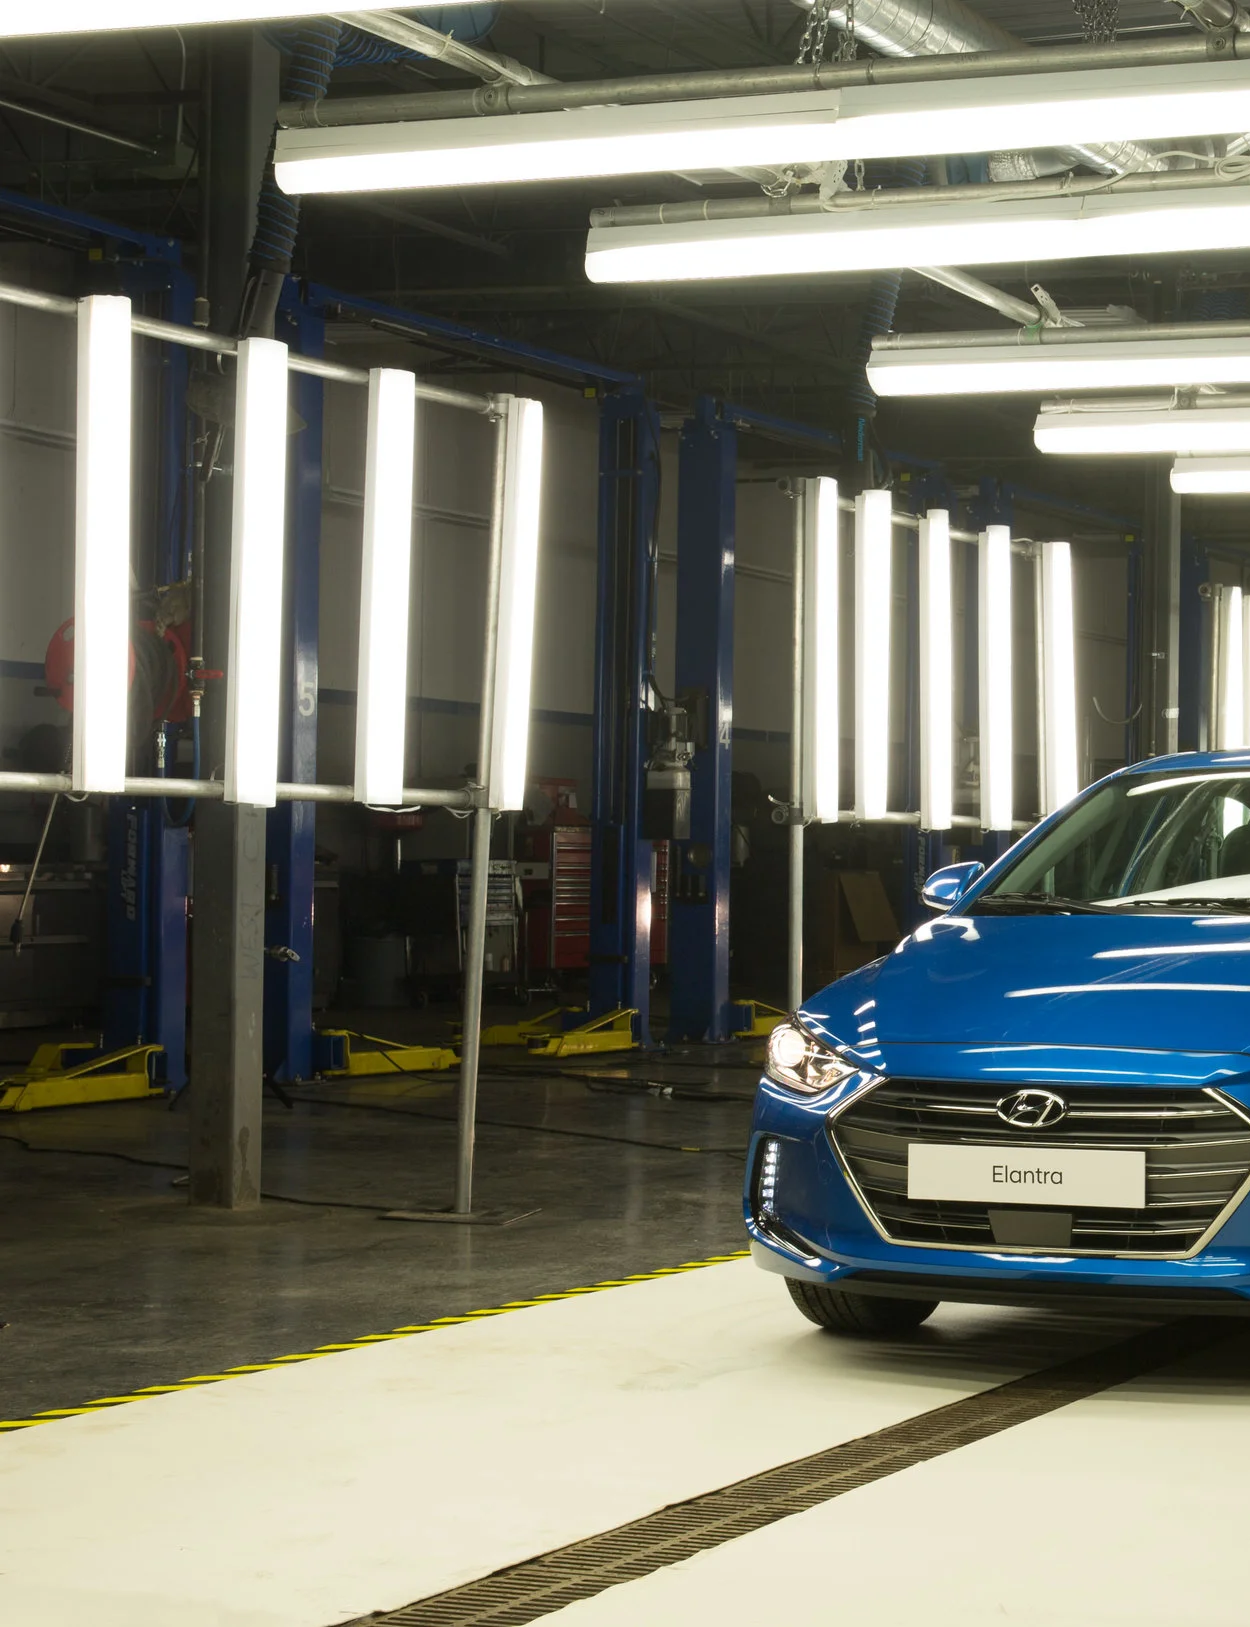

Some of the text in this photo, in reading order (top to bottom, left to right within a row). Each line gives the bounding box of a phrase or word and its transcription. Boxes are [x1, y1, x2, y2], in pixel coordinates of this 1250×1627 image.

[299, 682, 315, 717] 5
[720, 721, 731, 750] 4
[126, 813, 138, 922] FORWARD
[992, 1165, 1063, 1185] Elantra
